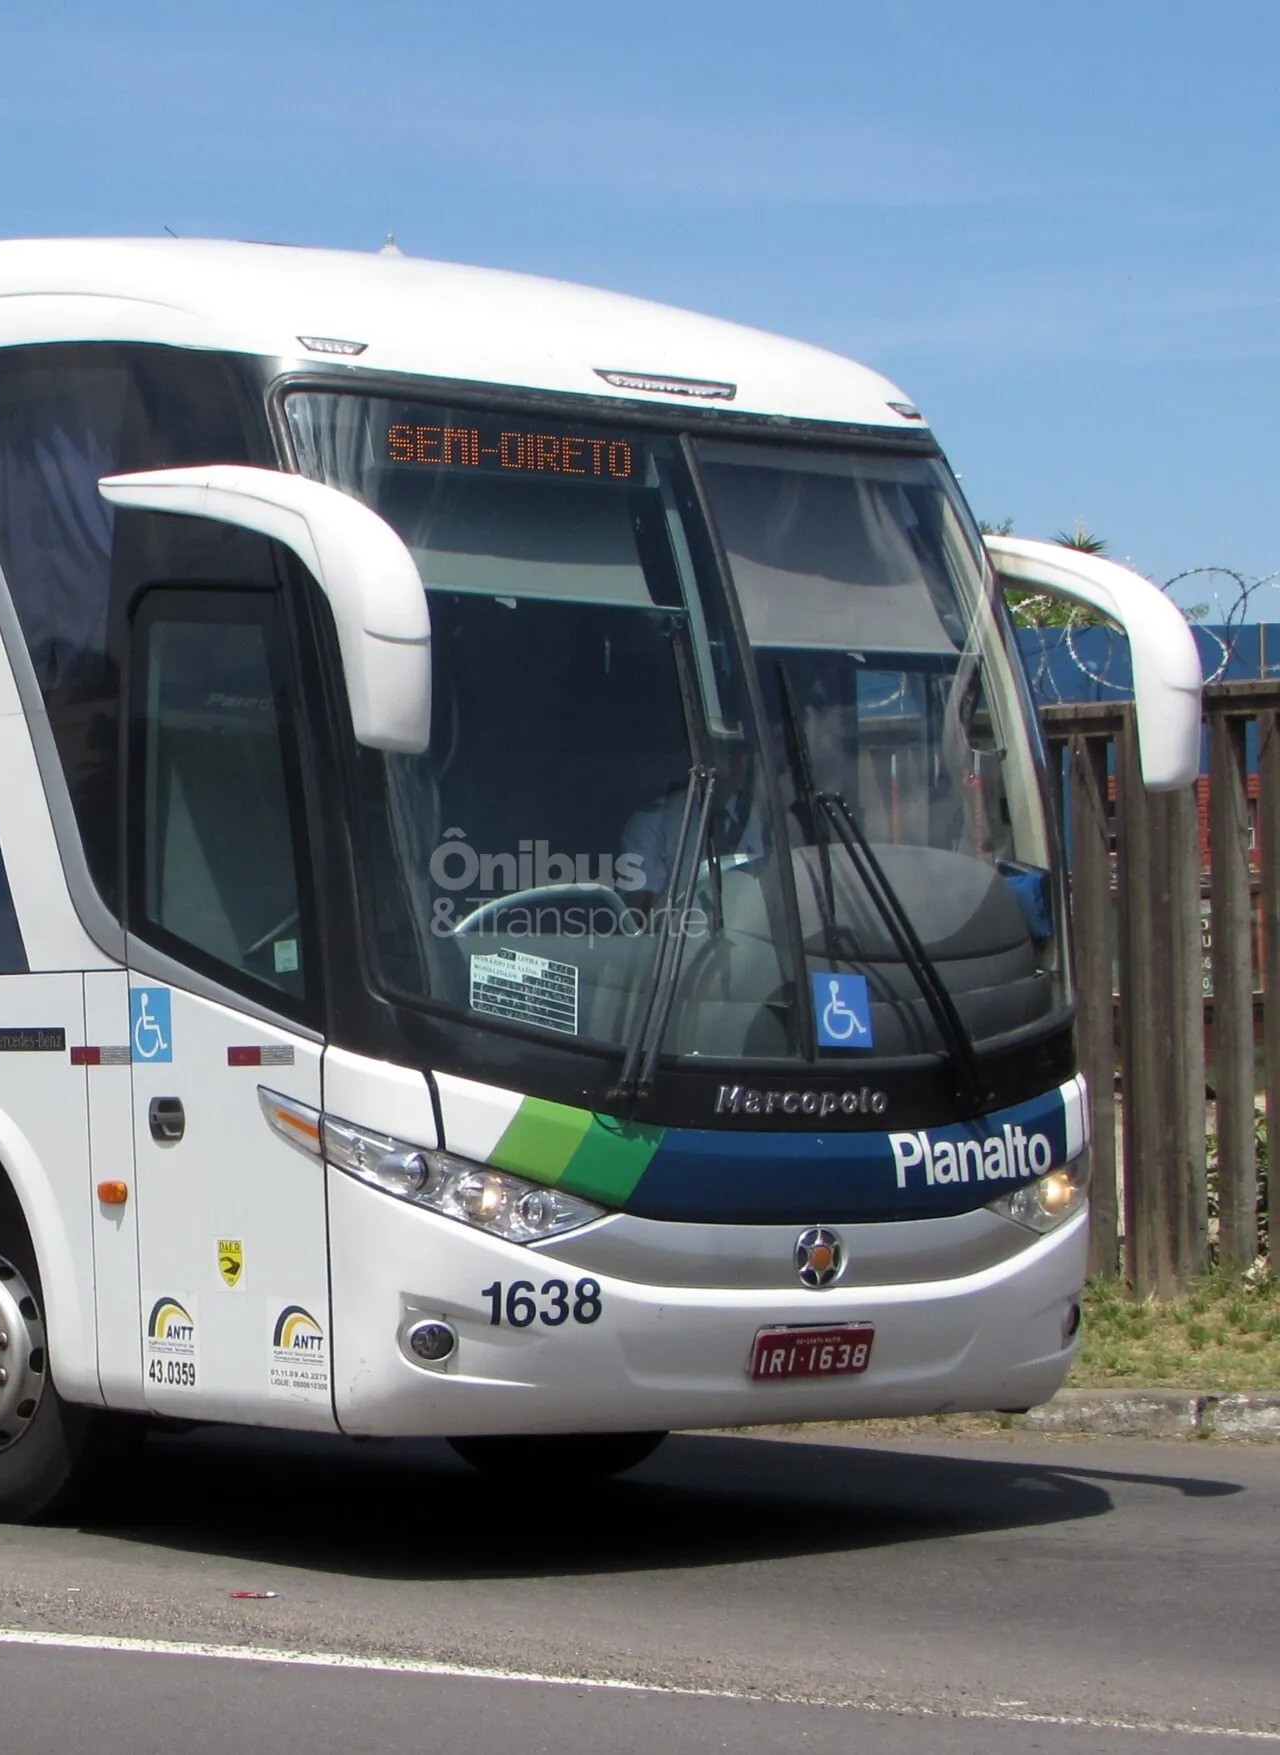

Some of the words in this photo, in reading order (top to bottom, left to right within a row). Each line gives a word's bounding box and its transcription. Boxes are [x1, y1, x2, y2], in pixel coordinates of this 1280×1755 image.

[389, 425, 631, 477] SEMI-DIRETO
[714, 1084, 889, 1116] Marcopolo
[888, 1124, 1052, 1189] Planalto
[480, 1277, 603, 1329] 1638
[166, 1325, 194, 1340] ANTT
[293, 1335, 324, 1350] ANTT
[148, 1359, 196, 1386] 43.0359
